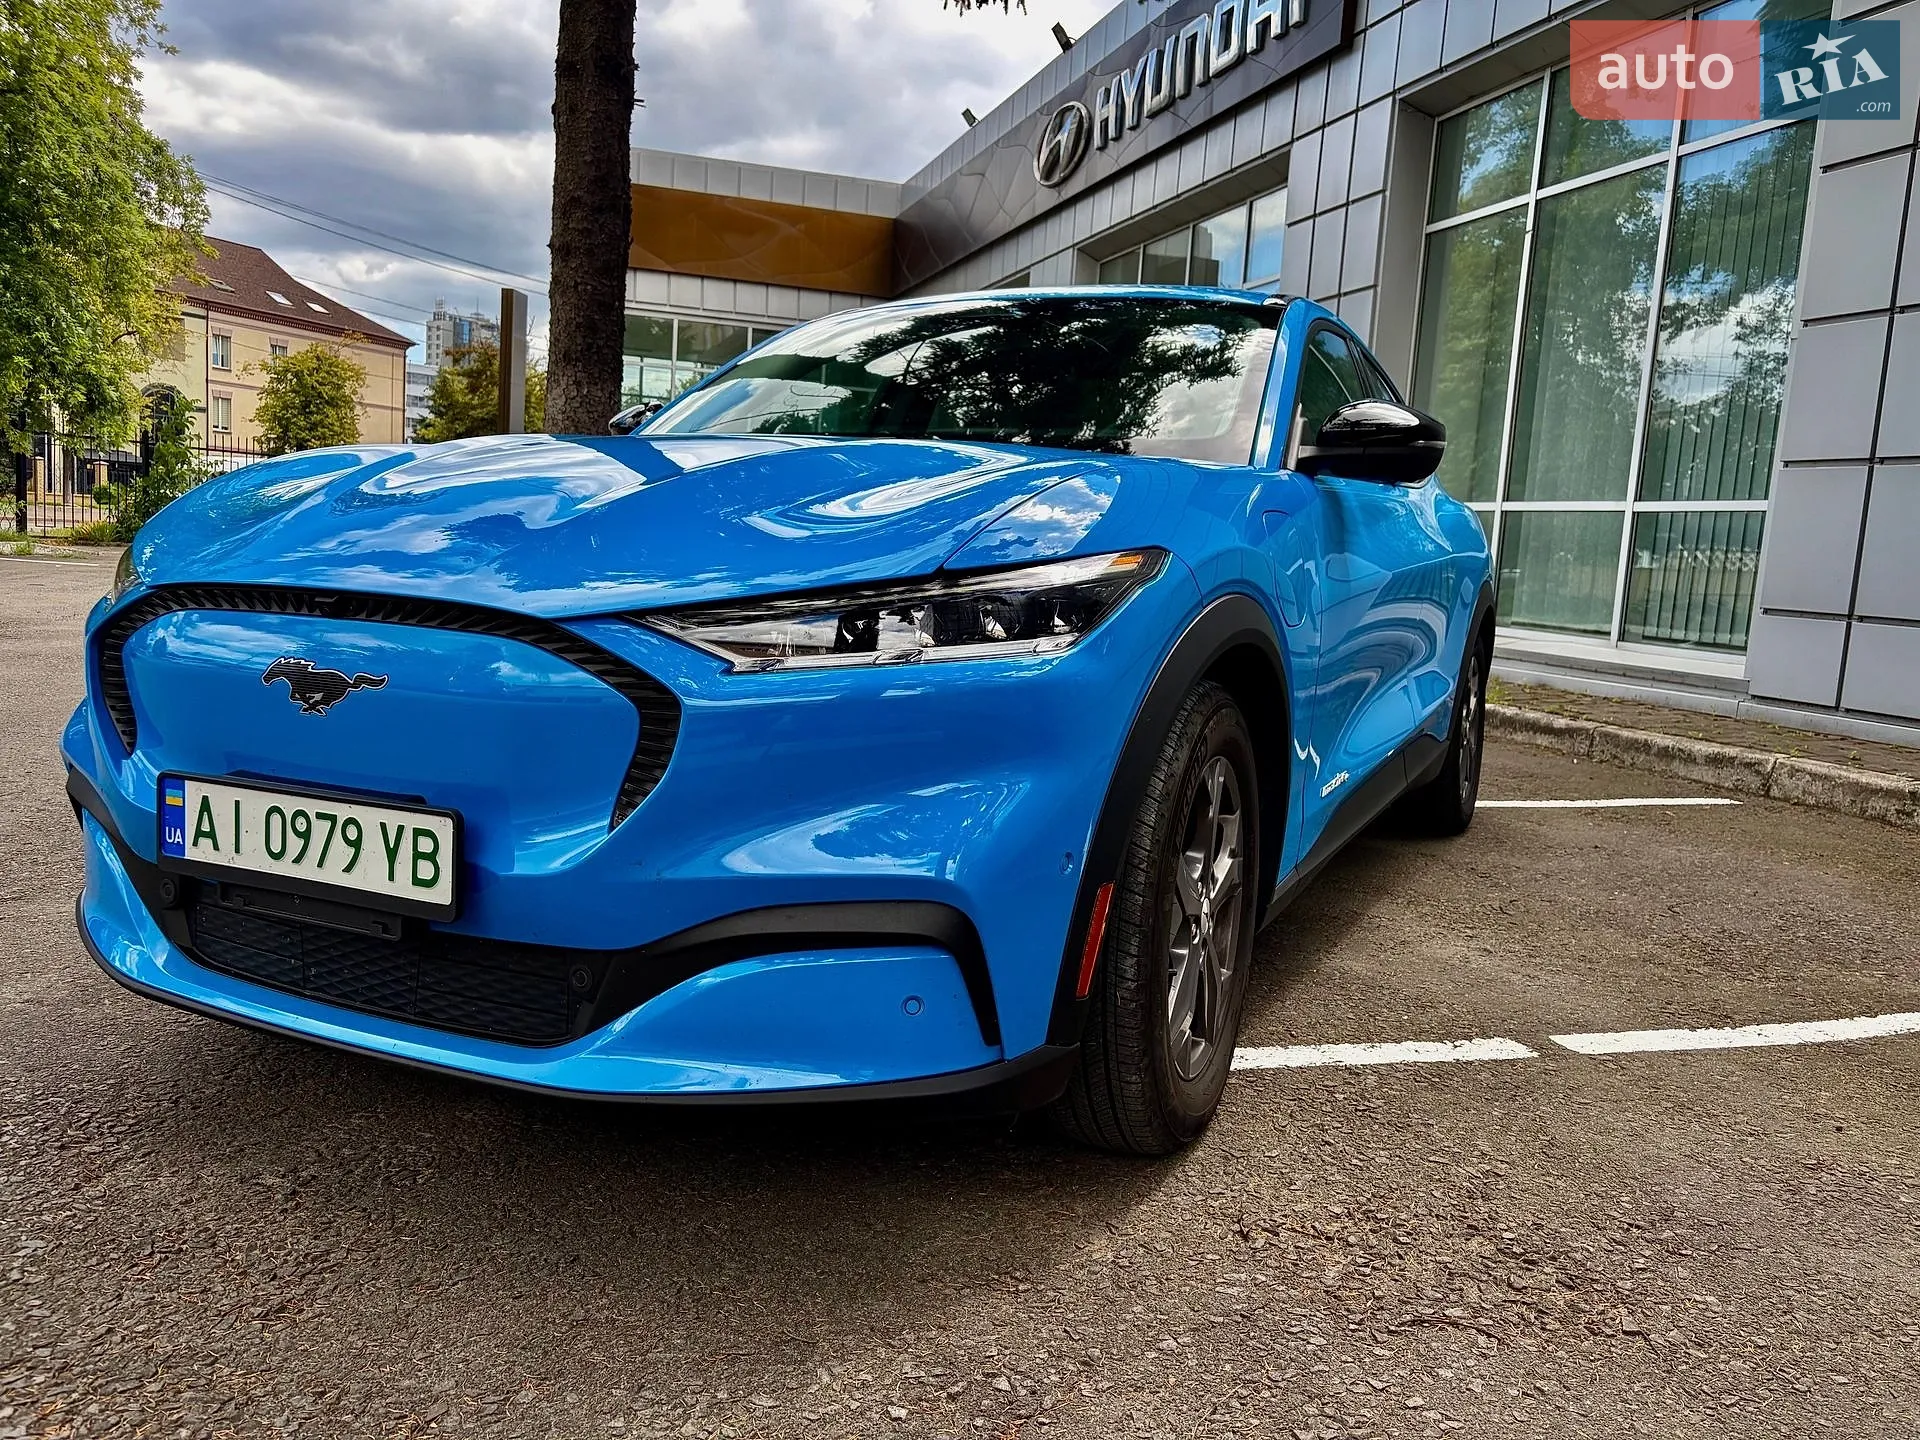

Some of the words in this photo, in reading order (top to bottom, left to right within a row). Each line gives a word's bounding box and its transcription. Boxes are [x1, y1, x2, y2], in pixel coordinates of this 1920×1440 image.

[165, 829, 183, 845] UA
[192, 795, 241, 854] AI
[264, 805, 363, 873] 0979
[379, 821, 441, 889] YB
